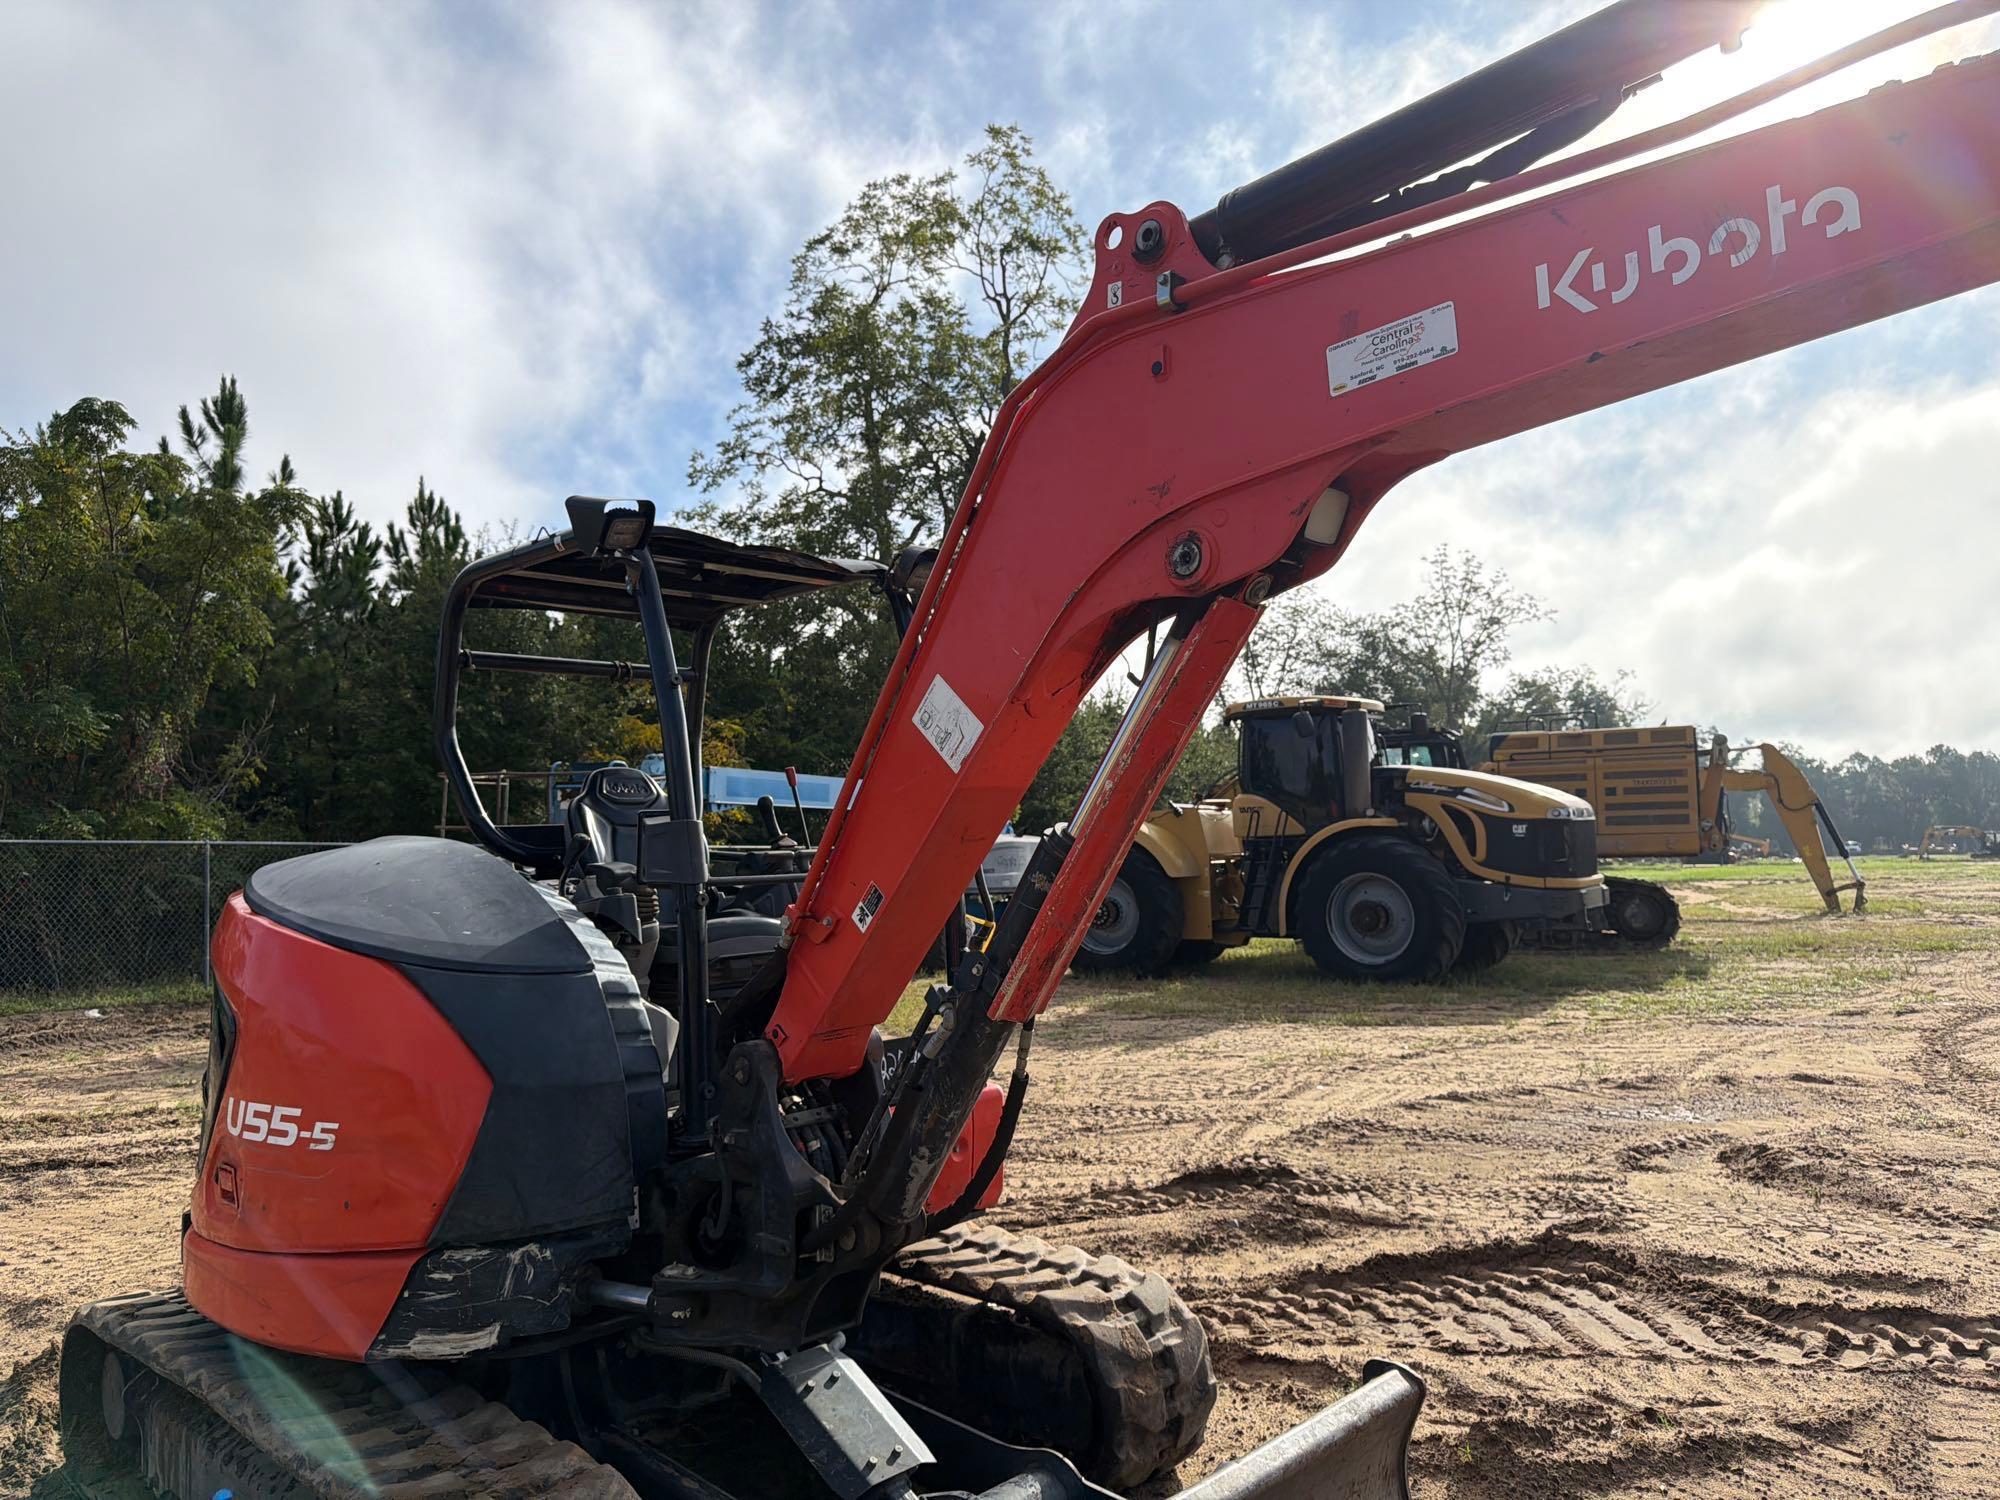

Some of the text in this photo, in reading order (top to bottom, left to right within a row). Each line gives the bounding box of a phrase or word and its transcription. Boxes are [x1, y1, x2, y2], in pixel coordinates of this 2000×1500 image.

[1534, 184, 1862, 313] Kubota
[1371, 323, 1413, 347] Central
[1372, 337, 1414, 357] Carolina
[1349, 368, 1375, 381] Sanford,
[1512, 824, 1528, 834] CAT
[226, 1096, 340, 1151] U55-5
